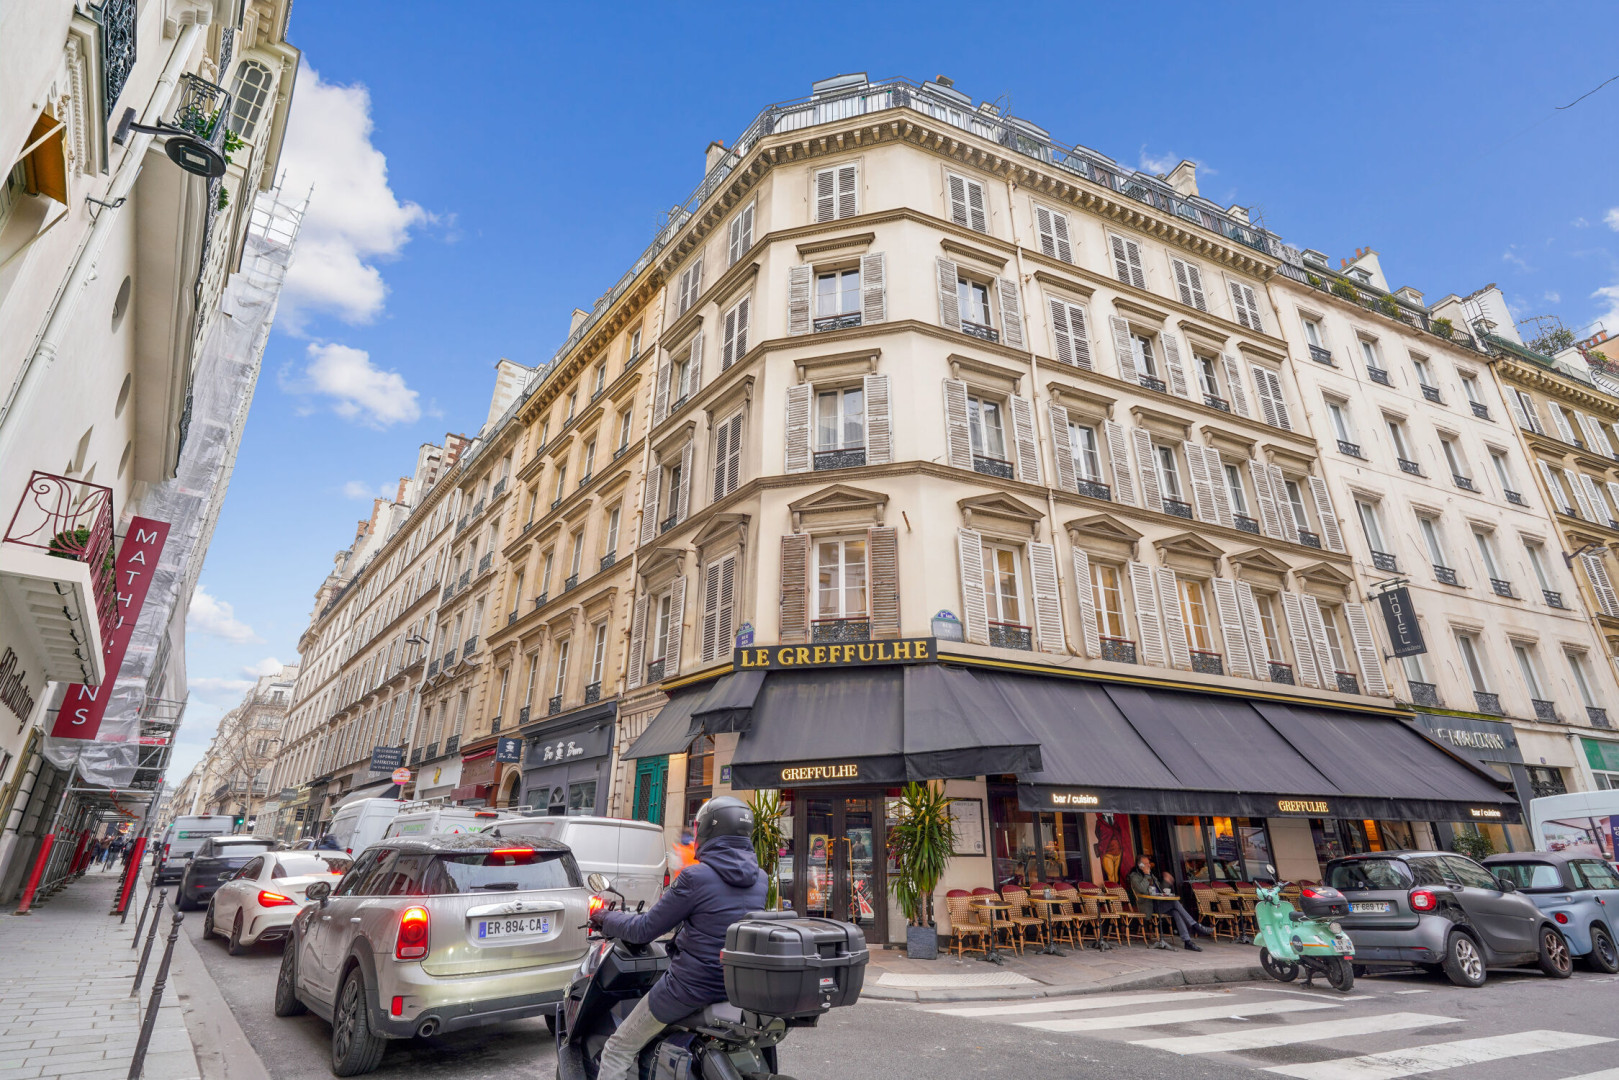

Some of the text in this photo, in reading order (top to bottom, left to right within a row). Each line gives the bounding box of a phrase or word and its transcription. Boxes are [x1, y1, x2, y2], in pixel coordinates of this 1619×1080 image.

[71, 528, 158, 725] MATHNS
[1388, 593, 1411, 645] HOTEL
[741, 641, 929, 667] LE GREFFULHE
[781, 764, 858, 781] GREFFULHE
[1052, 793, 1066, 804] bar
[1072, 794, 1098, 805] cuisine
[1278, 800, 1329, 812] GREFFULHE
[487, 918, 542, 935] ER-894-CA
